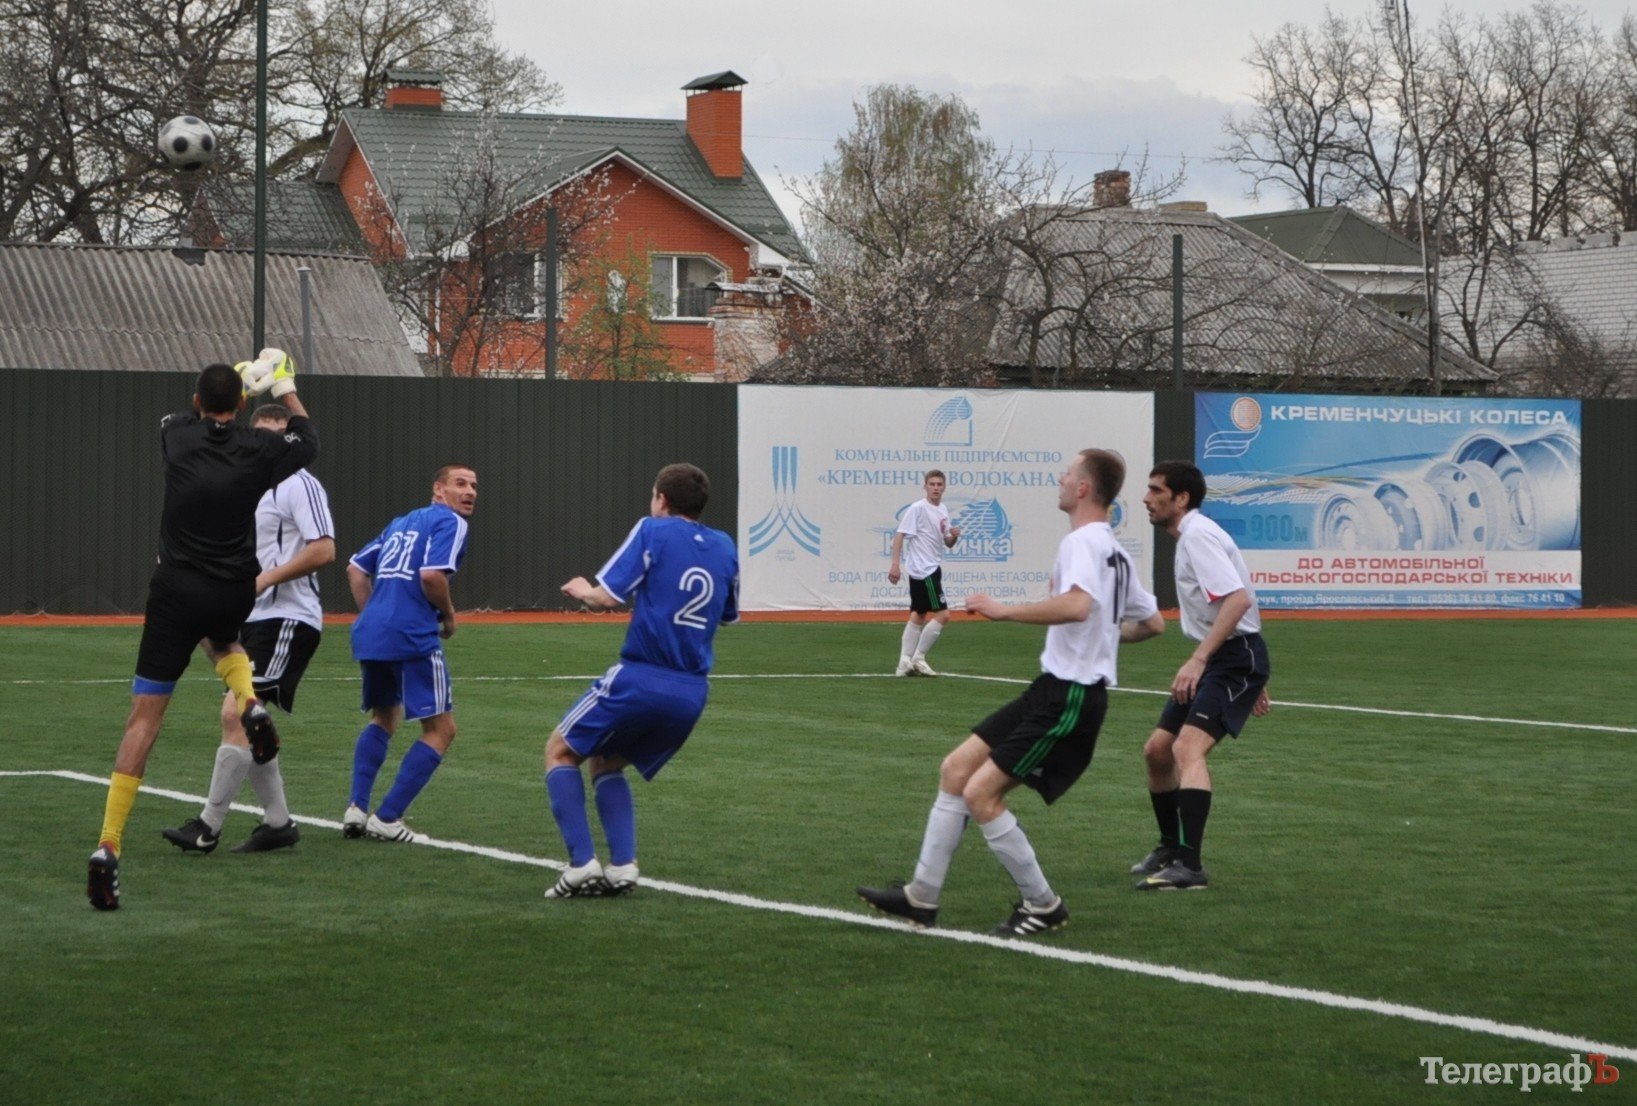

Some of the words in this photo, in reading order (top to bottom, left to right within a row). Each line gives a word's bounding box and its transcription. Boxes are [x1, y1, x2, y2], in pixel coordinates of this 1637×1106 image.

[1270, 405, 1462, 426] КРЕМЕНЧУЦЬКІ
[1469, 409, 1569, 426] КОЛЕСА
[834, 448, 940, 463] КОМУНАЛЬНЕ
[944, 450, 1063, 464] ПІДПРИЄМСТВО
[1297, 557, 1324, 570] ДО
[1331, 556, 1486, 570] АВТОМОБІЛЬНОЇ
[828, 572, 861, 584] ВОДА
[1494, 572, 1574, 585] ТЕХНІКИ
[672, 566, 715, 630] 2
